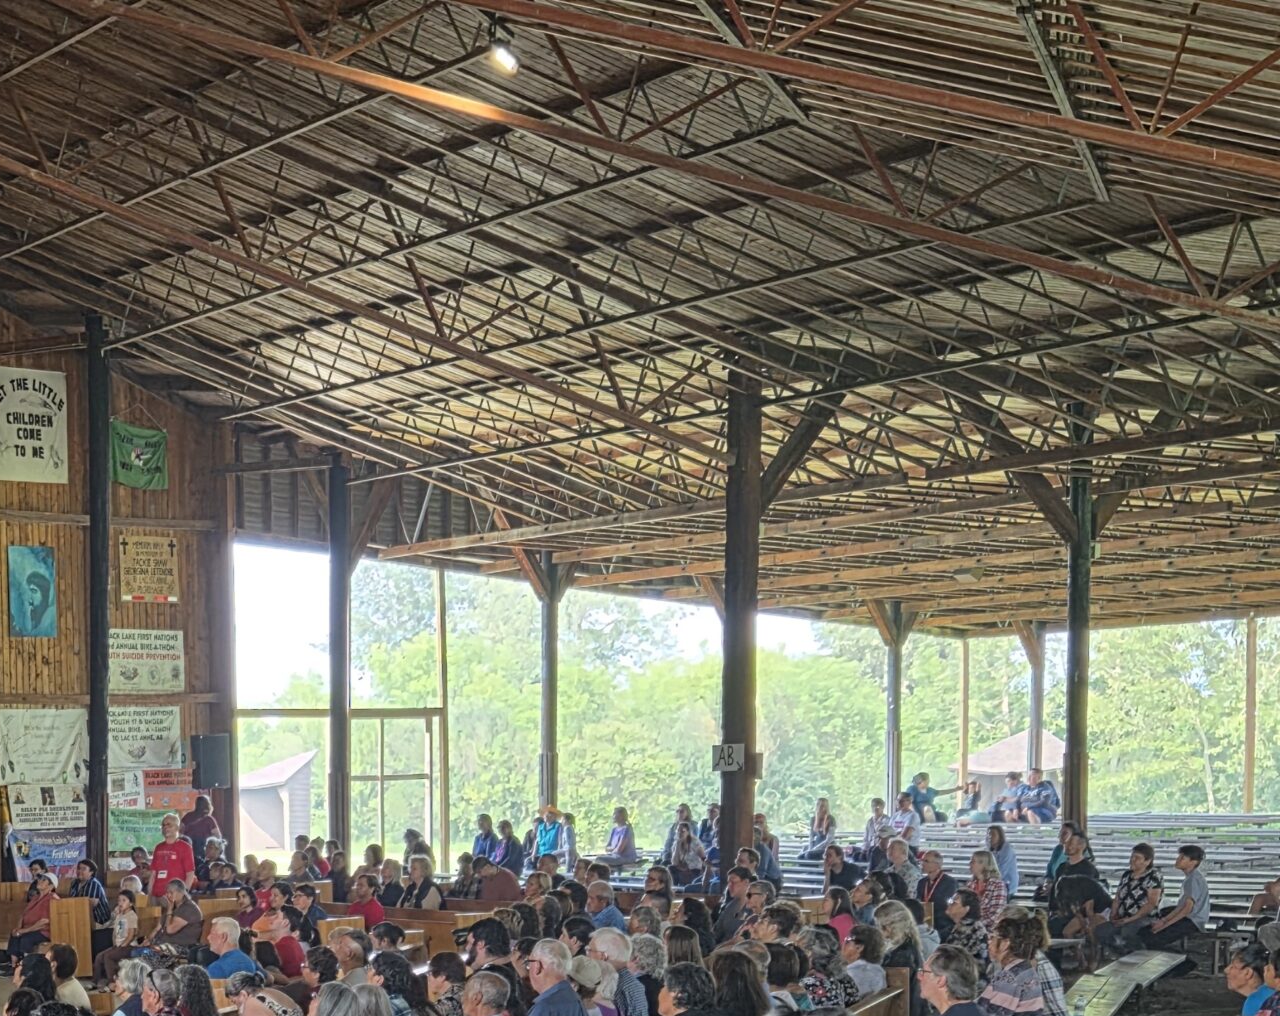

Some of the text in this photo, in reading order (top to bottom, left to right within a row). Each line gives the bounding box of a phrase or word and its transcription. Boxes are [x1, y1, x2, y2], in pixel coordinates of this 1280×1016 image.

[10, 378, 29, 392] THE
[32, 379, 65, 412] LITTLE
[6, 412, 53, 428] CHILDREN
[16, 427, 42, 441] COME
[14, 444, 45, 459] TO ME
[121, 633, 136, 641] LAKE
[137, 633, 153, 641] FIRST
[154, 634, 179, 642] NATIONS
[122, 652, 145, 660] SUICIDE
[146, 653, 181, 661] PREVENTION
[717, 745, 734, 767] AB
